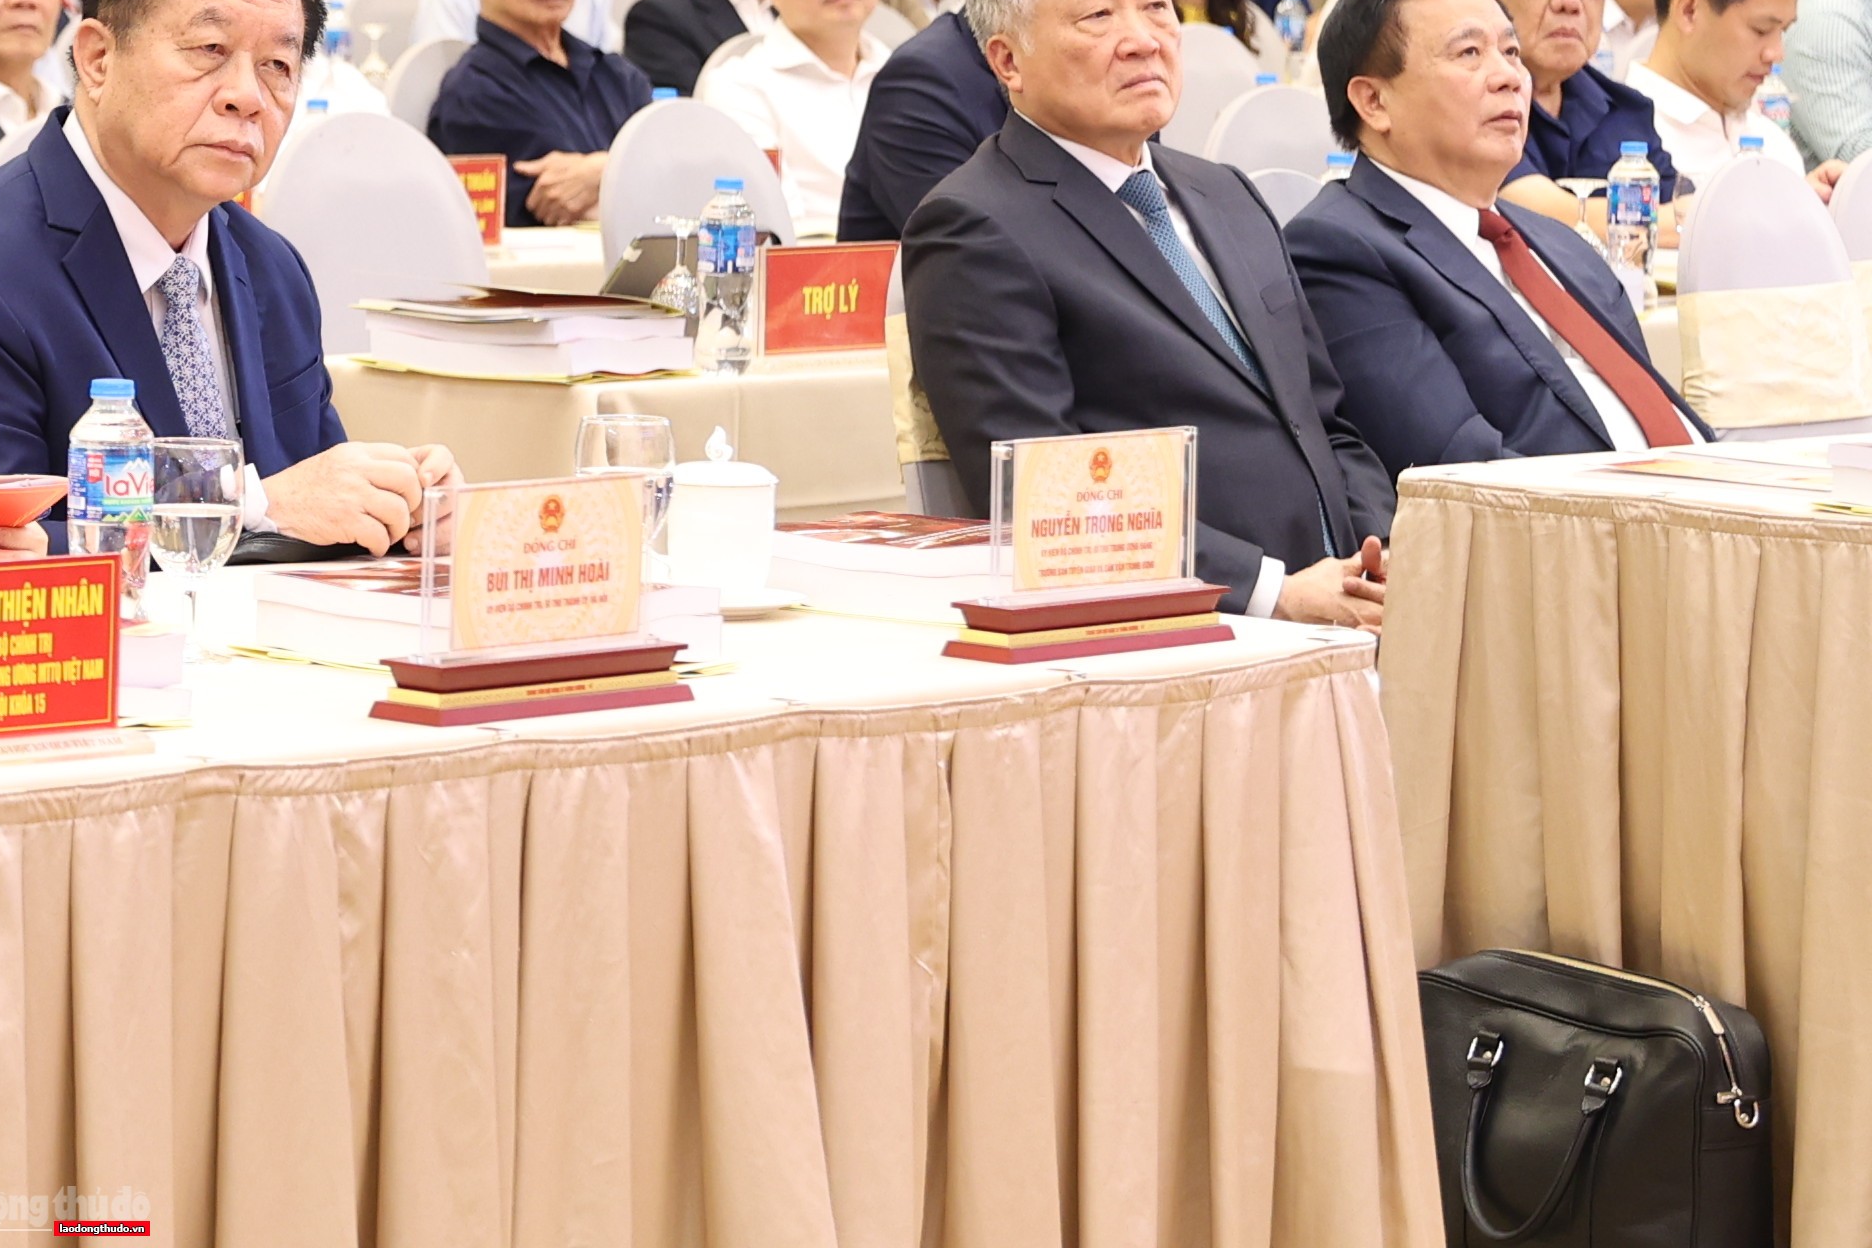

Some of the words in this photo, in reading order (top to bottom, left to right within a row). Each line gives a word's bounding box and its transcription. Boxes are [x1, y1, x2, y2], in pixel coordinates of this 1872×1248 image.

[802, 282, 835, 319] TRỢ
[839, 278, 860, 313] LÝ
[1031, 511, 1081, 539] NGUYỄN
[1085, 513, 1124, 538] TRỌNG
[1127, 507, 1163, 531] NGHĨA
[486, 567, 509, 593] BÙI
[513, 566, 534, 594] THỊ
[538, 564, 575, 588] MINH
[578, 558, 611, 583] HOÀI
[50, 577, 105, 620] NHÂN
[82, 657, 105, 681] NAM
[34, 693, 47, 714] 15
